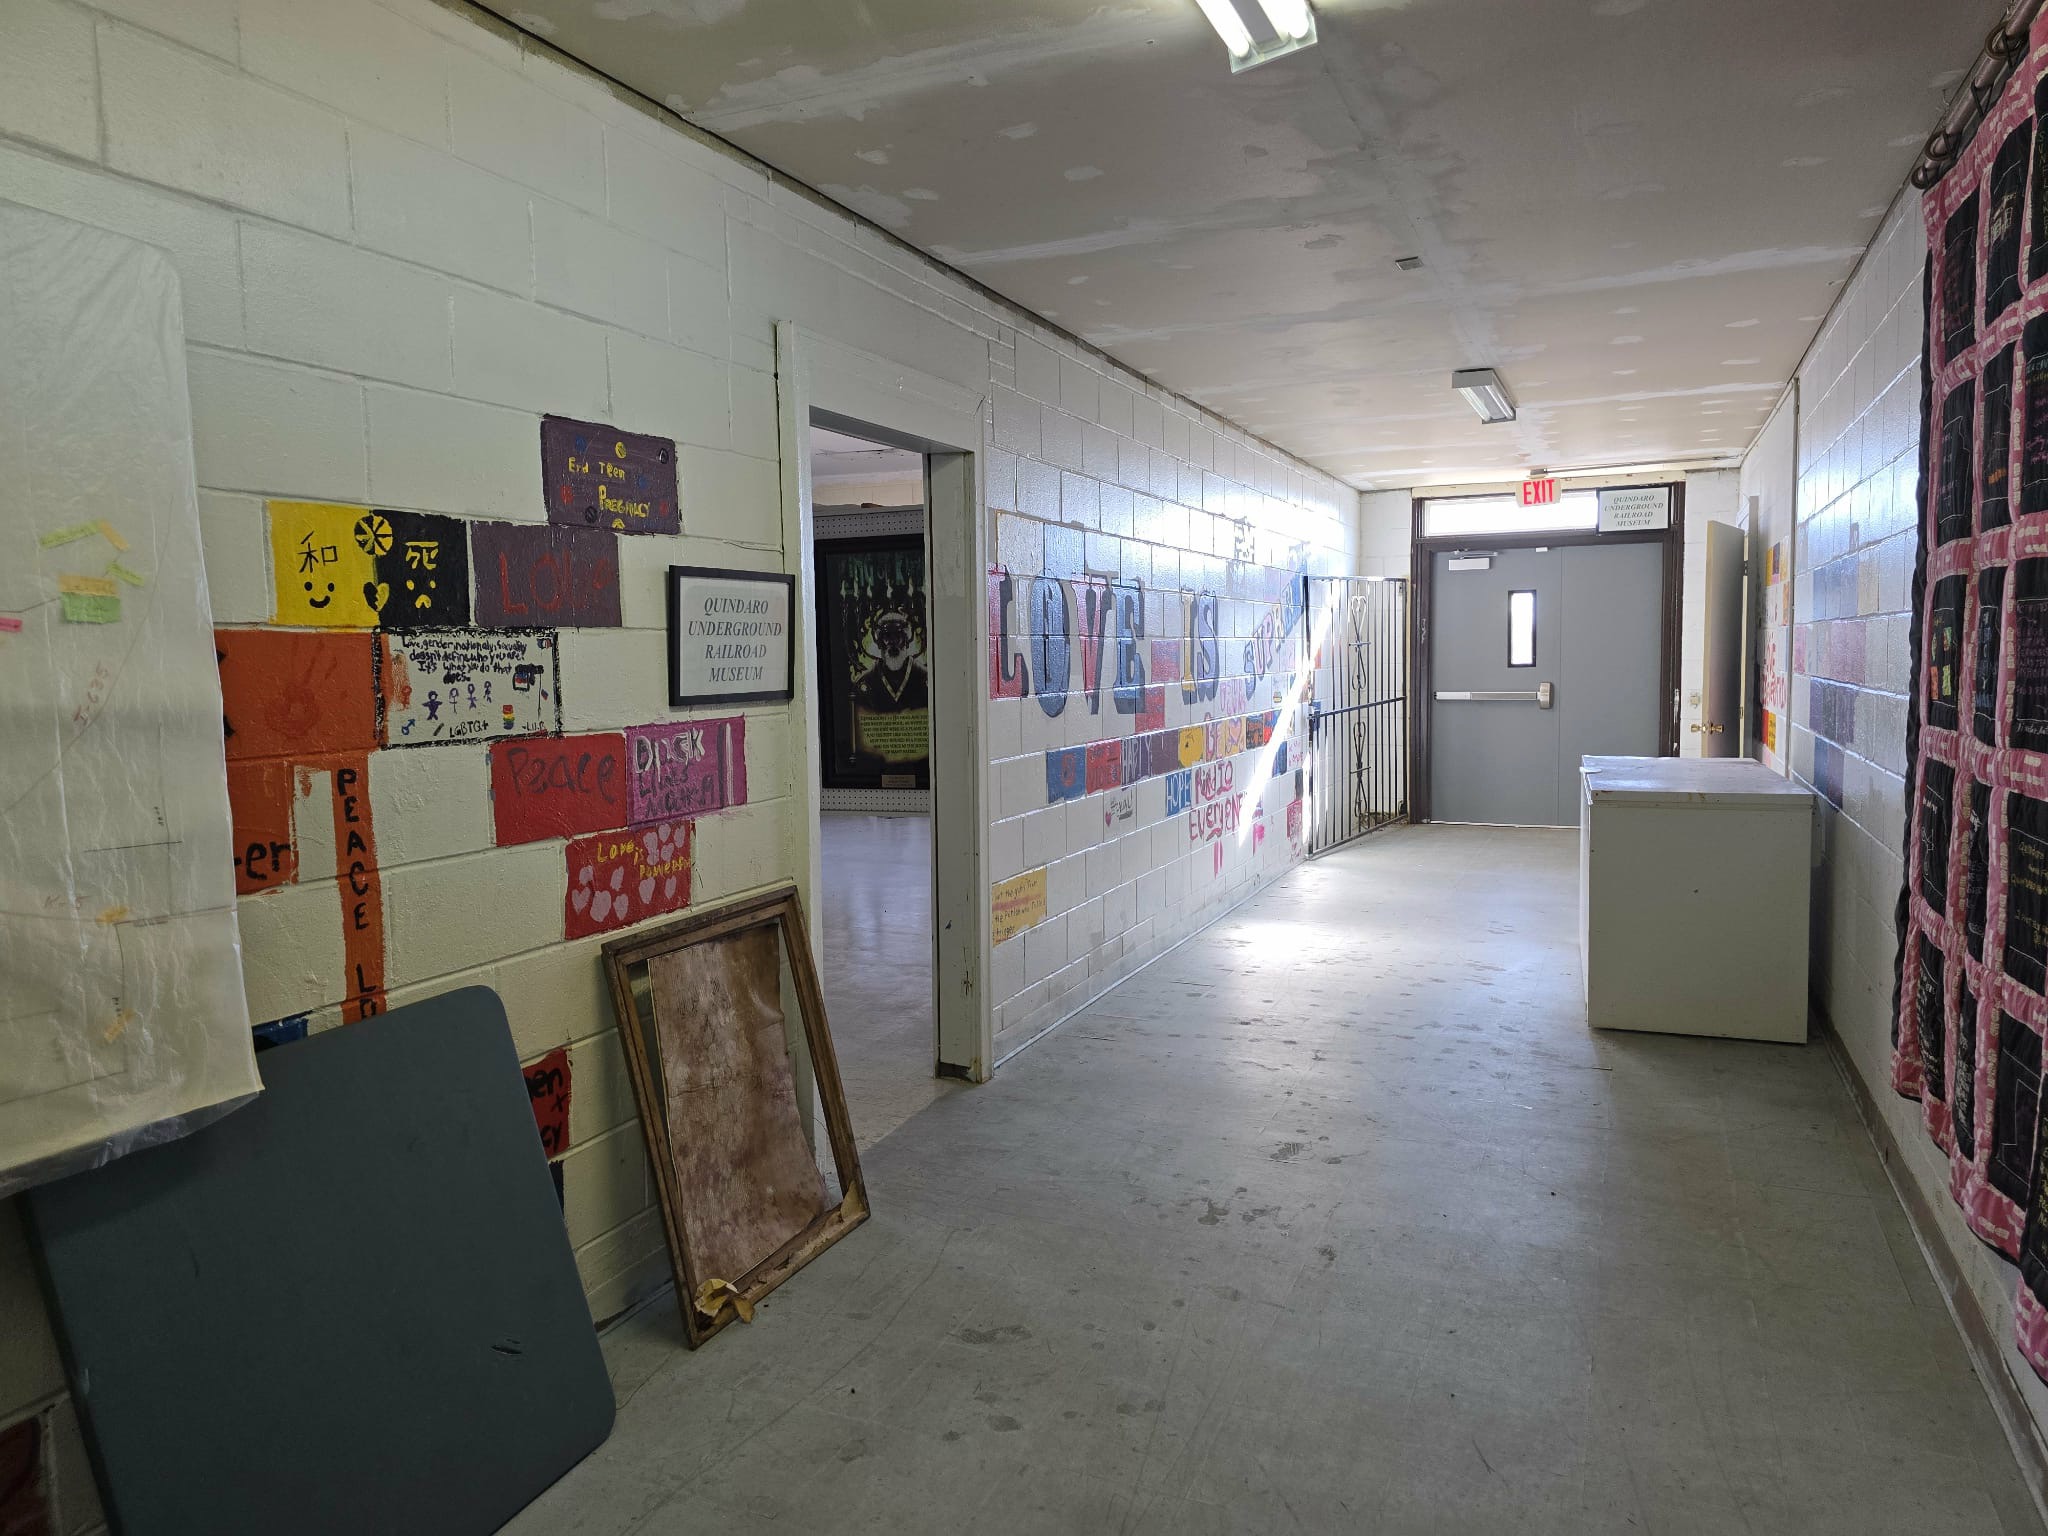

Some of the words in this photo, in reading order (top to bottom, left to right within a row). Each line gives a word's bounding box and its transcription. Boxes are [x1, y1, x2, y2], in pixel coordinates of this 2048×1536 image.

[1522, 479, 1555, 506] EXIT
[1613, 494, 1656, 505] QUINDARO
[1603, 502, 1664, 513] UNDERGROUND
[1613, 511, 1654, 520] RAILROAD
[1615, 519, 1652, 528] MUSEUM
[297, 530, 339, 574] 和
[704, 597, 769, 616] QUINDARO
[688, 620, 782, 637] UNDERGROUND
[988, 562, 1146, 718] LOVE
[1180, 584, 1220, 706] IS
[705, 644, 767, 660] RAILROAD
[709, 666, 763, 682] MUSEUM
[449, 720, 489, 738] LGBTQ+
[1166, 771, 1191, 812] HOPE
[336, 768, 369, 931] PEACE
